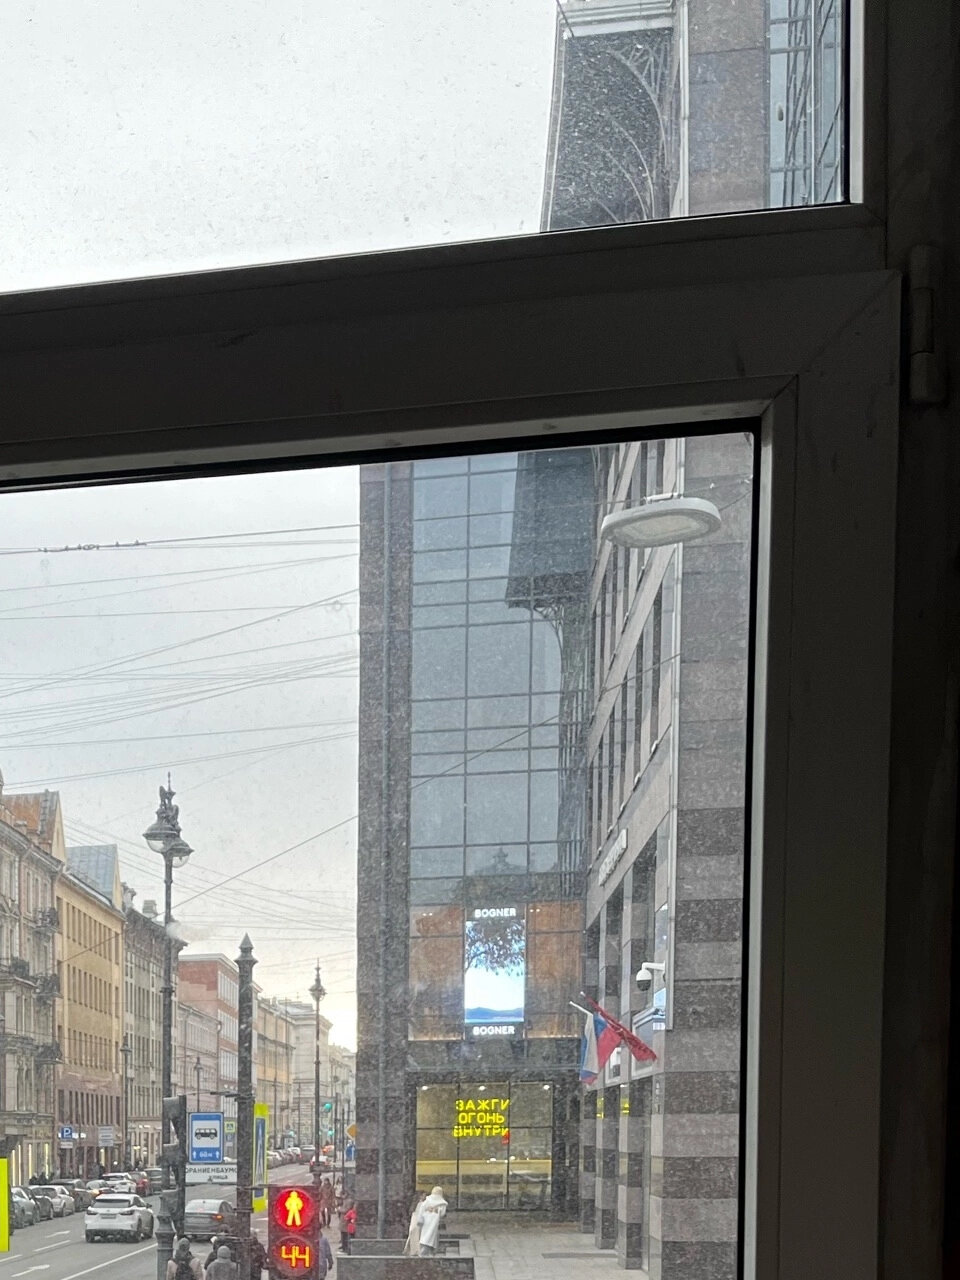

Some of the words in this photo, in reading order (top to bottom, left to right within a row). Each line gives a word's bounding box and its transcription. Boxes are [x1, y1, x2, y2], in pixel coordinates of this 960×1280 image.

[474, 907, 517, 918] BOGNER
[472, 1025, 515, 1036] BOGNER
[455, 1098, 510, 1111] ЗАЖГИ
[458, 1112, 505, 1124] ОГОНЬ
[453, 1125, 509, 1137] ВНУТРИ
[281, 1245, 310, 1268] 44
